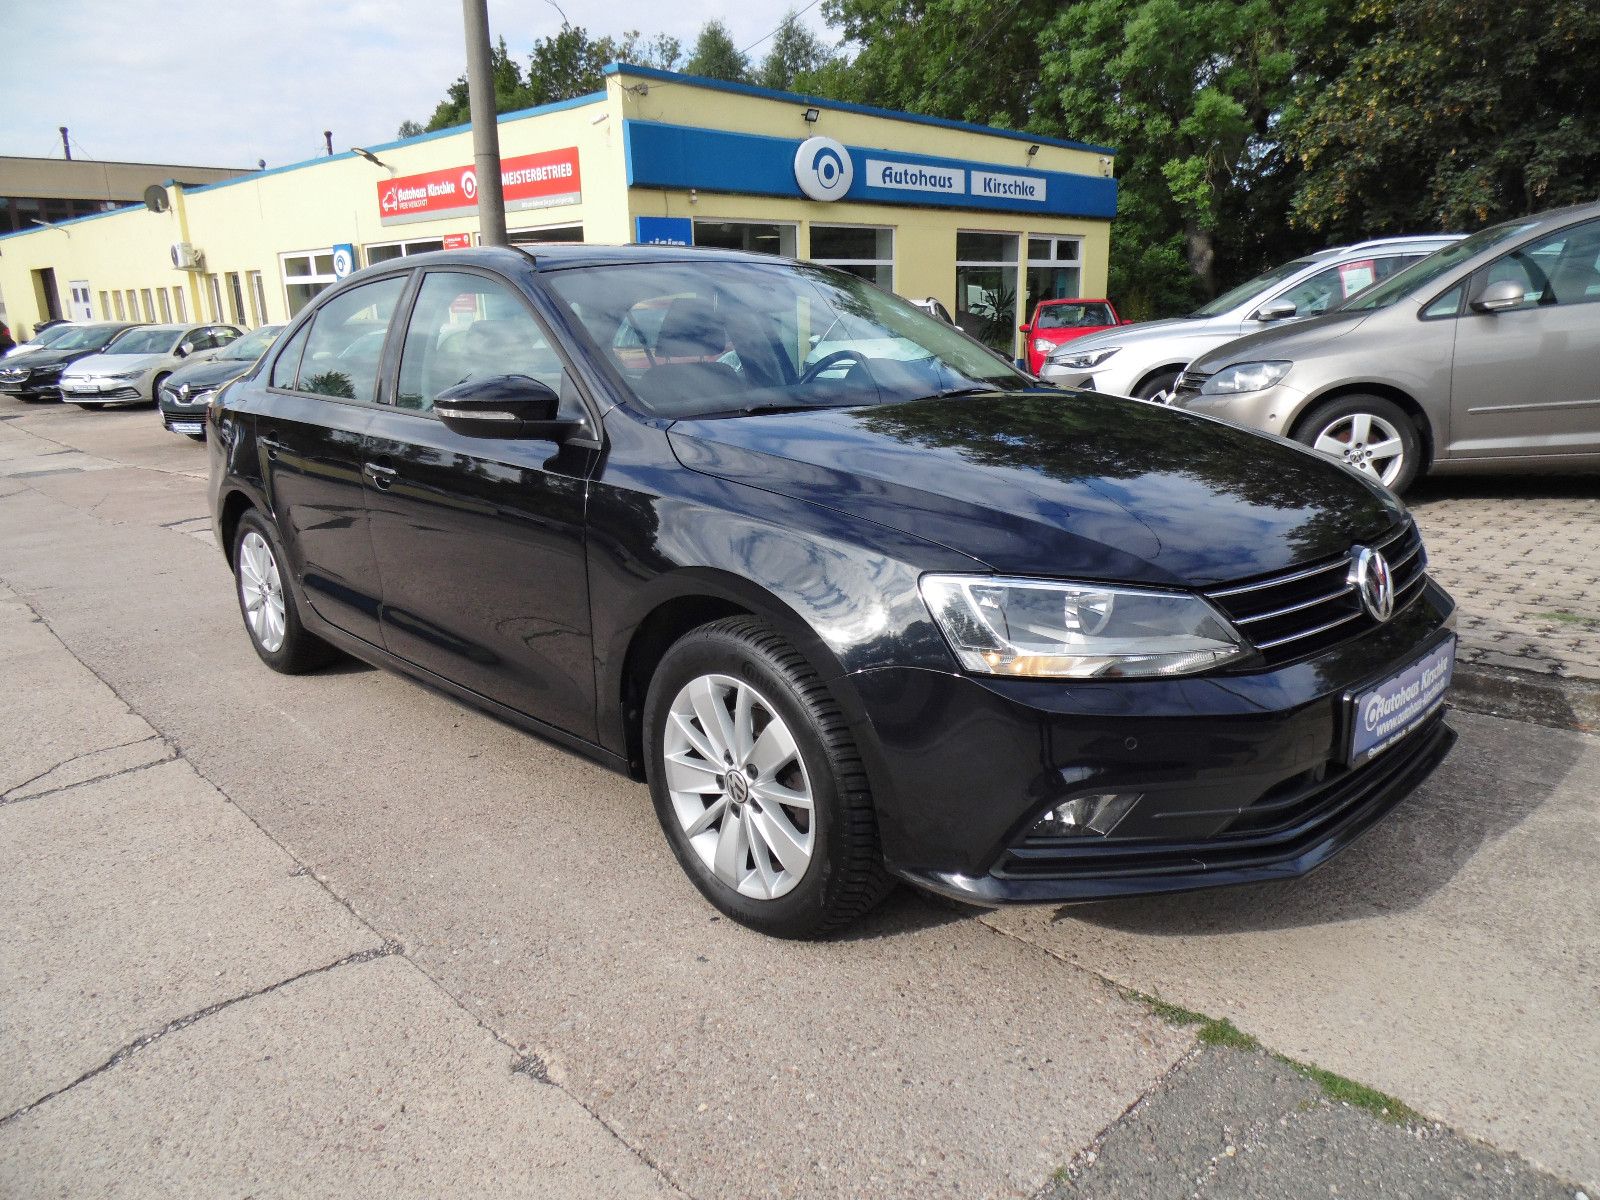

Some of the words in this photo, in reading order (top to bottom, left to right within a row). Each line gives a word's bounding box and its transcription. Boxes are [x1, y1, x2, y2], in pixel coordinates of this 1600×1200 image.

[502, 163, 572, 186] MEISTERBETRIEB
[882, 166, 953, 189] Autohaus
[983, 177, 1035, 197] Kirschke
[398, 187, 427, 202] Autohaus
[427, 181, 455, 196] Kirschke
[1376, 681, 1420, 720] Autohaus
